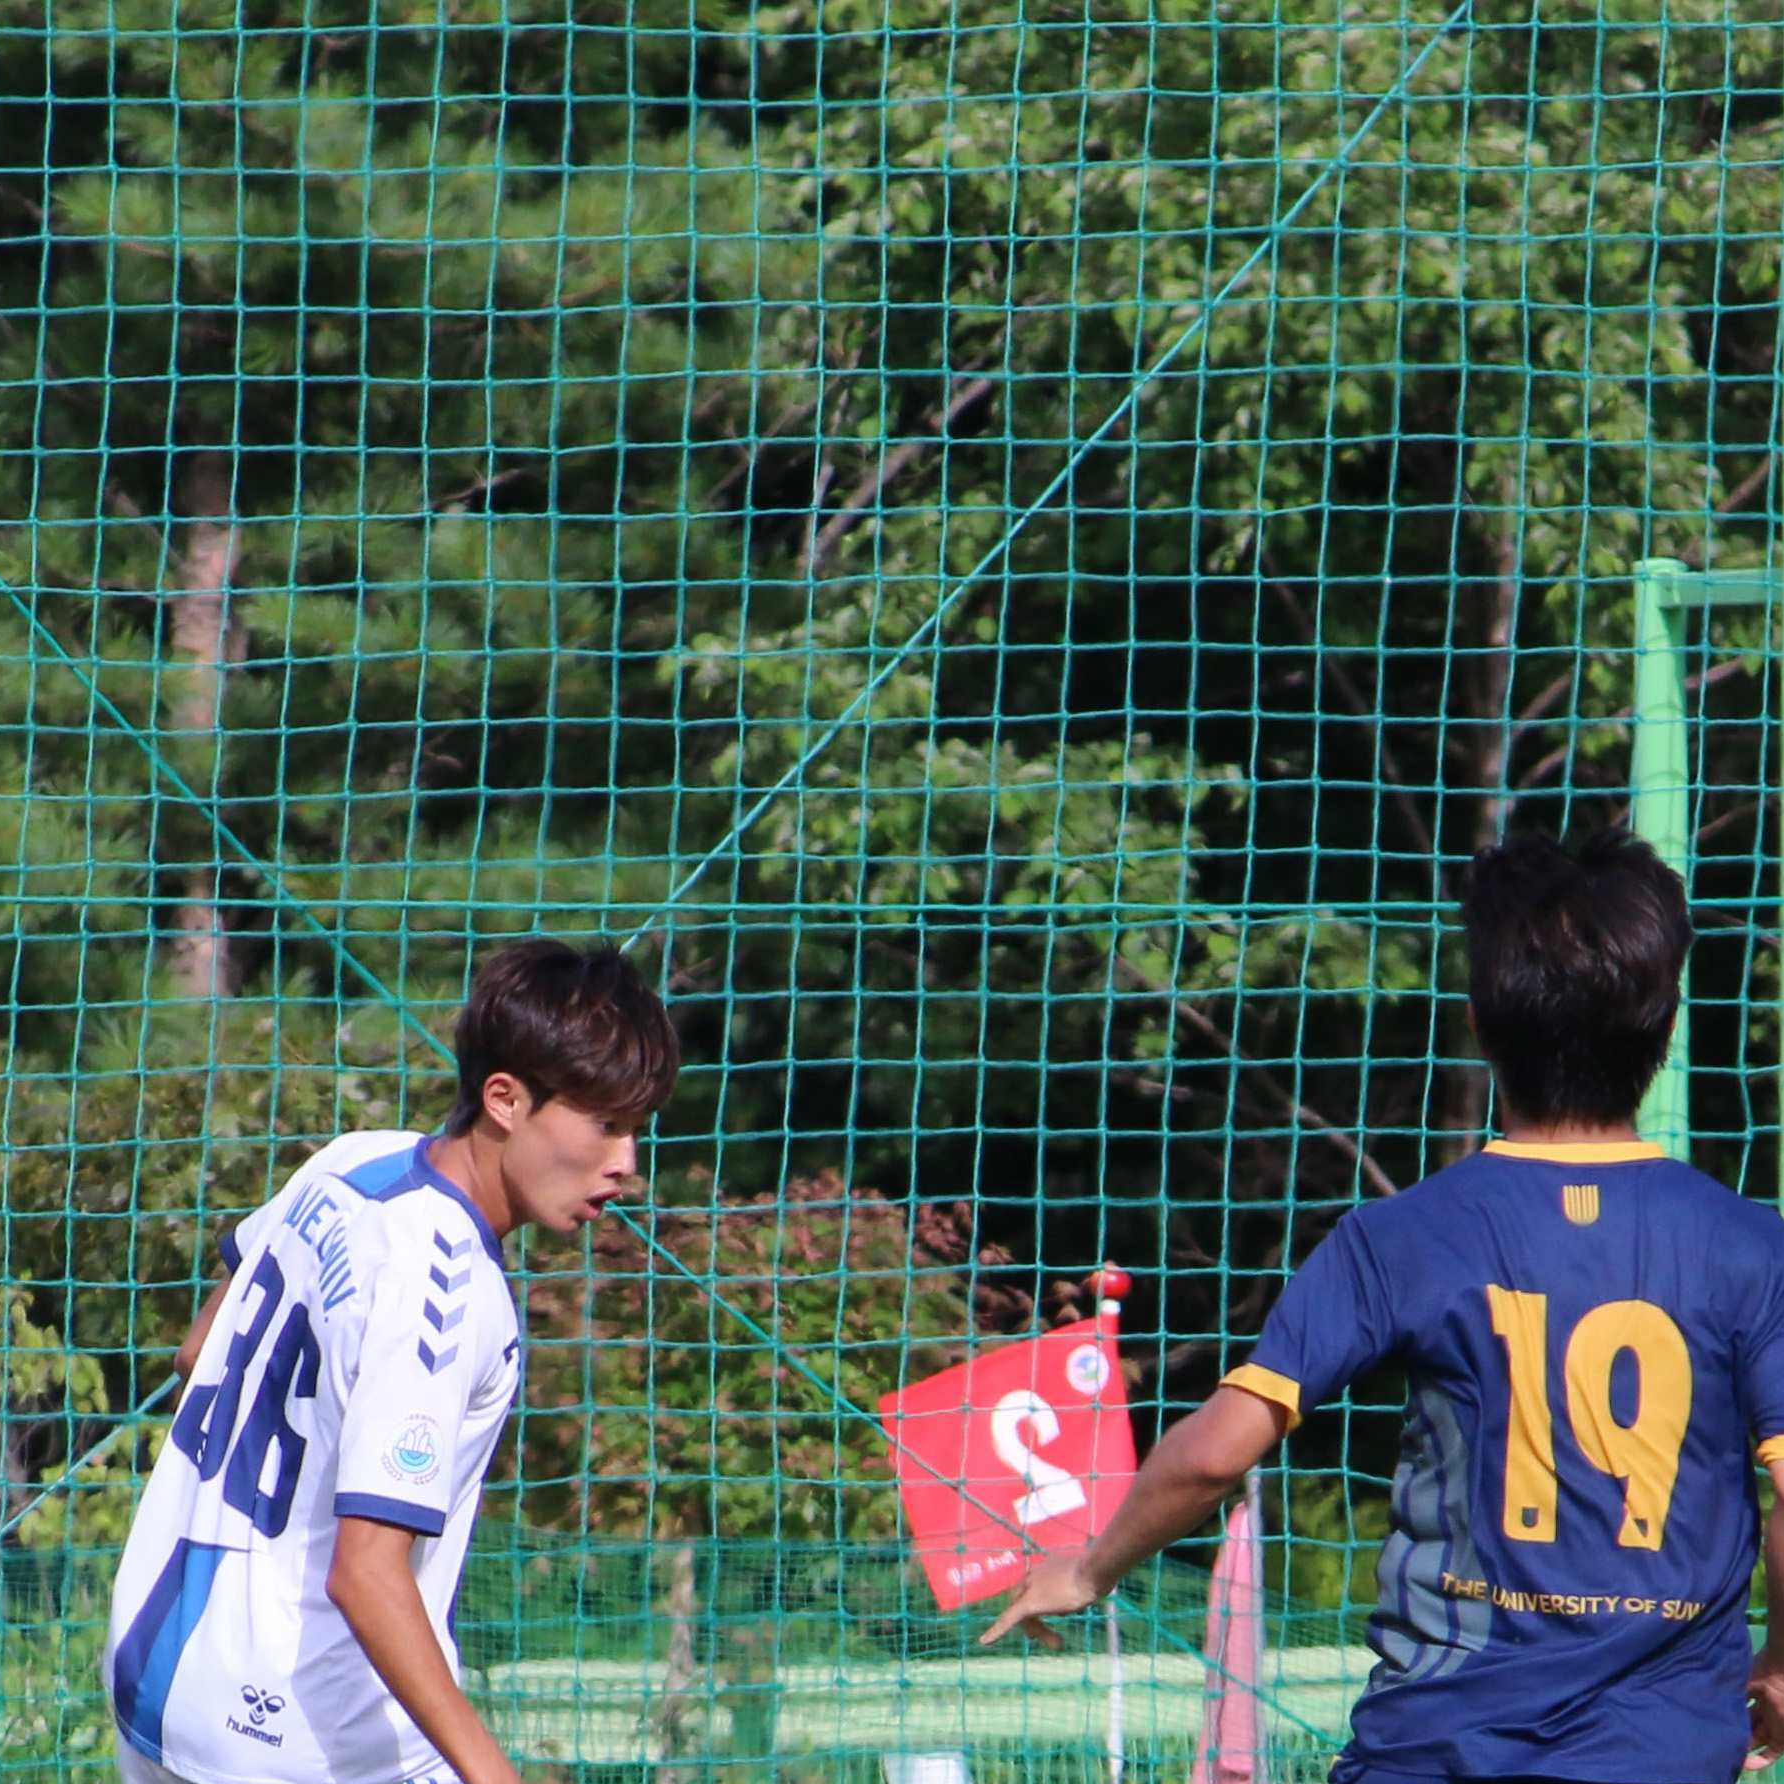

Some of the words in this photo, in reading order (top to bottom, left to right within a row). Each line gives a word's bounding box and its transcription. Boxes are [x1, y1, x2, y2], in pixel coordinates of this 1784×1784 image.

[1486, 1283, 1692, 1552] 19
[1442, 1571, 1487, 1600] THE
[1492, 1584, 1620, 1616] UNIVERSITY
[1624, 1596, 1656, 1614] OF
[225, 1713, 283, 1748] hummel
